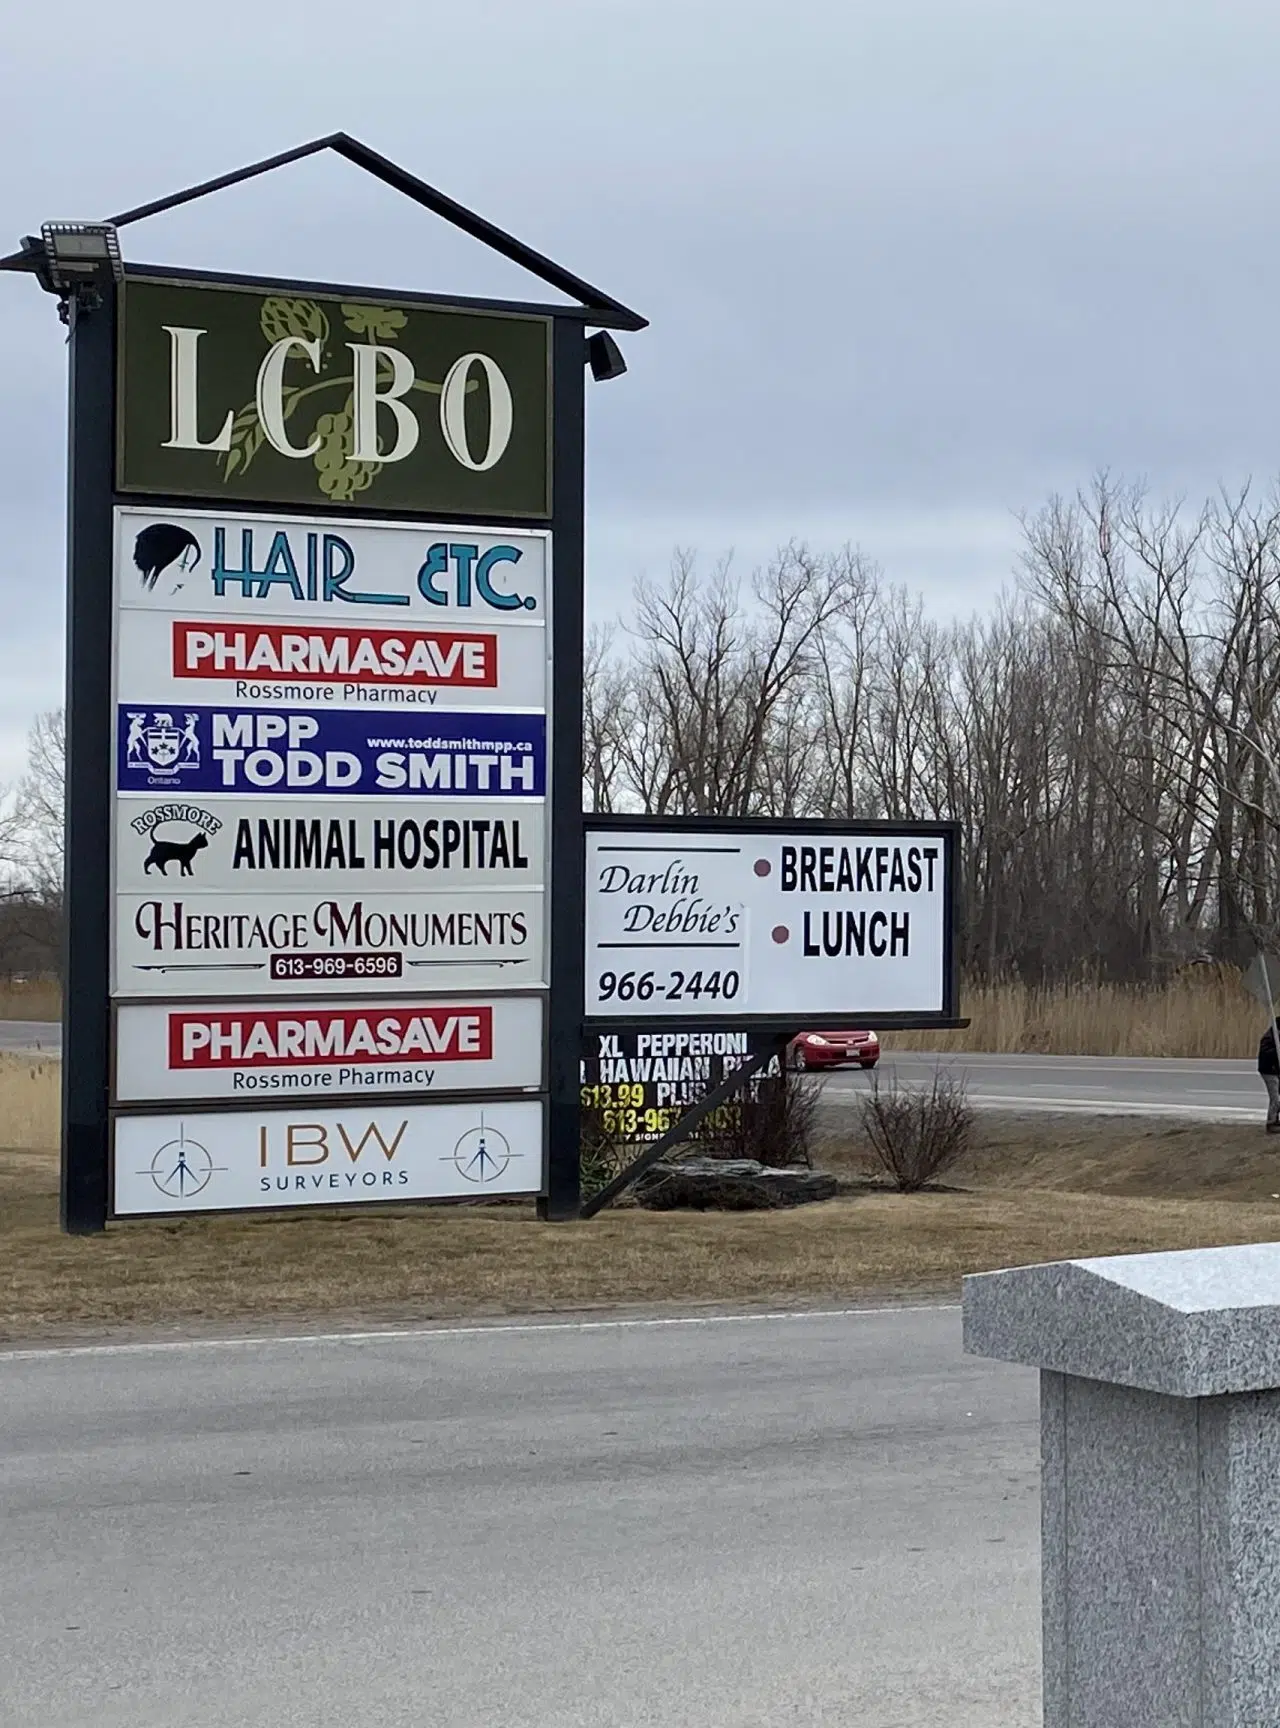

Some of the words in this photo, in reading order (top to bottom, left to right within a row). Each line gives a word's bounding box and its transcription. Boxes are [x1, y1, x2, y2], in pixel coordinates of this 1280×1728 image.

[161, 325, 514, 472] LCBO
[211, 526, 410, 606] HAIR
[417, 542, 537, 611] ETC.
[185, 631, 486, 680] PHARMASAVE
[236, 680, 334, 702] Rossmore
[343, 683, 438, 706] Pharmacy
[212, 713, 320, 748] MPP
[367, 737, 533, 754] www.toddsmithmpp.ca
[212, 749, 362, 787] TODD
[375, 752, 535, 790] SMITH
[130, 803, 223, 836] ROSSMORE
[232, 819, 365, 870] ANIMAL
[374, 819, 529, 869] HOSPITAL
[598, 860, 699, 894] Darlin
[780, 845, 939, 893] BREAKFAST
[134, 901, 308, 950] HERITAGE
[313, 900, 529, 947] MONUMENTS
[623, 897, 741, 934] Debbie's
[802, 910, 910, 957] LUNCH
[275, 956, 398, 977] 613-969-6596
[598, 969, 740, 1001] 966-2440
[181, 1015, 481, 1060] PHARMASAVE
[599, 1034, 623, 1058] XL
[637, 1032, 747, 1057] PEPPERONI
[233, 1069, 332, 1090] Rossmore
[339, 1066, 435, 1088] Pharmacy
[600, 1056, 710, 1084] HAWAIIAN
[260, 1120, 409, 1167] IBW
[260, 1170, 409, 1191] SURVEYORS
